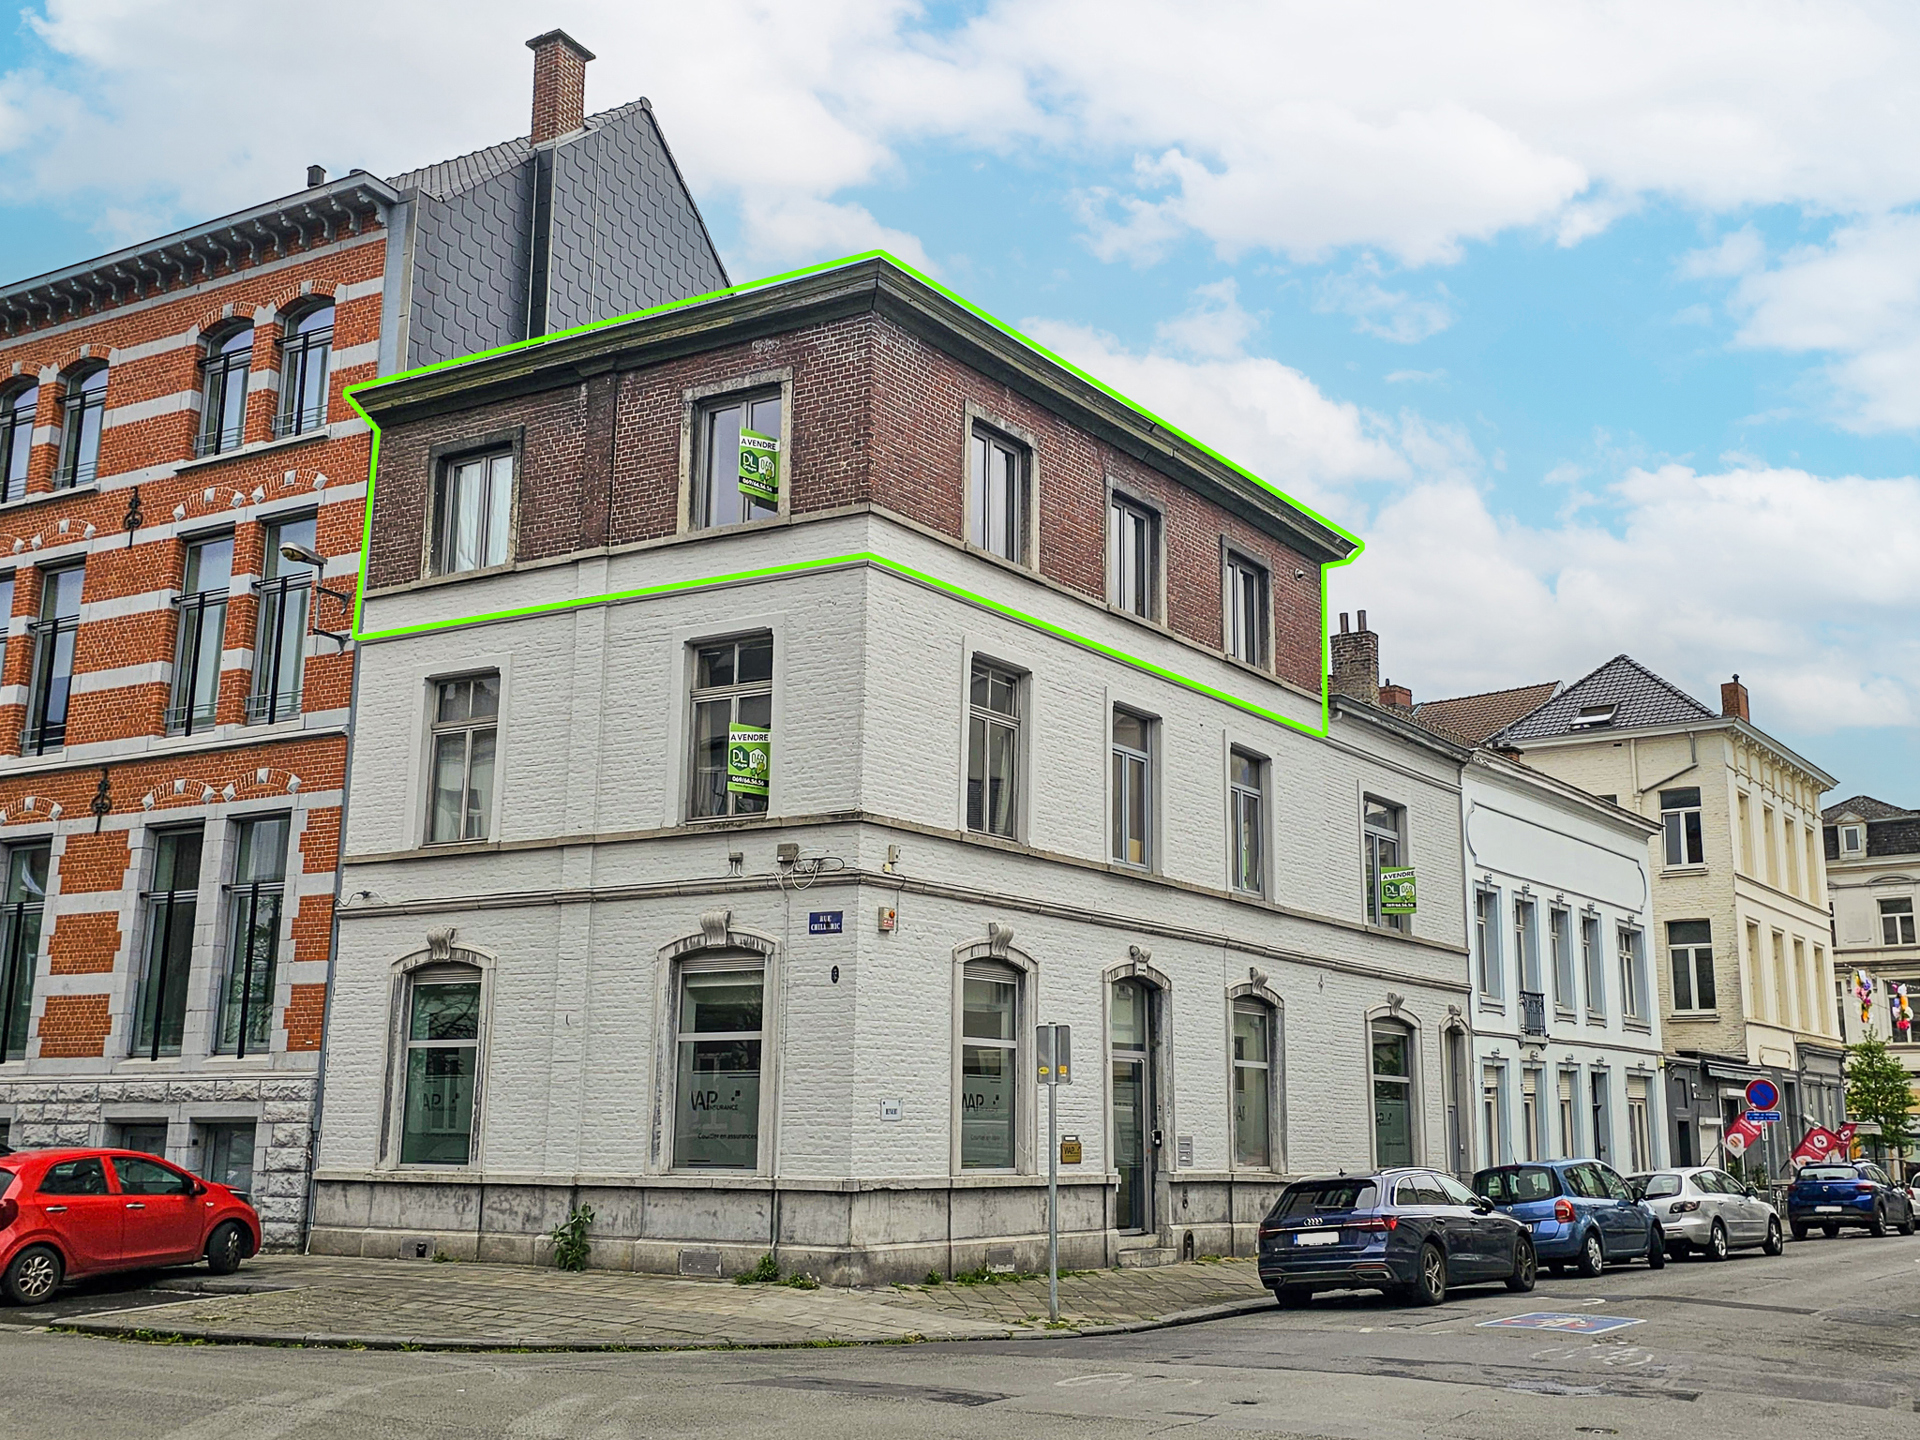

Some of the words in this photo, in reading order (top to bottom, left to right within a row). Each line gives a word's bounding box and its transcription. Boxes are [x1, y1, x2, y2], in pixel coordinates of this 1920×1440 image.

[747, 439, 776, 451] VENDRE
[732, 749, 747, 763] DL
[1388, 871, 1415, 879] VENDRE
[819, 915, 832, 923] RUE
